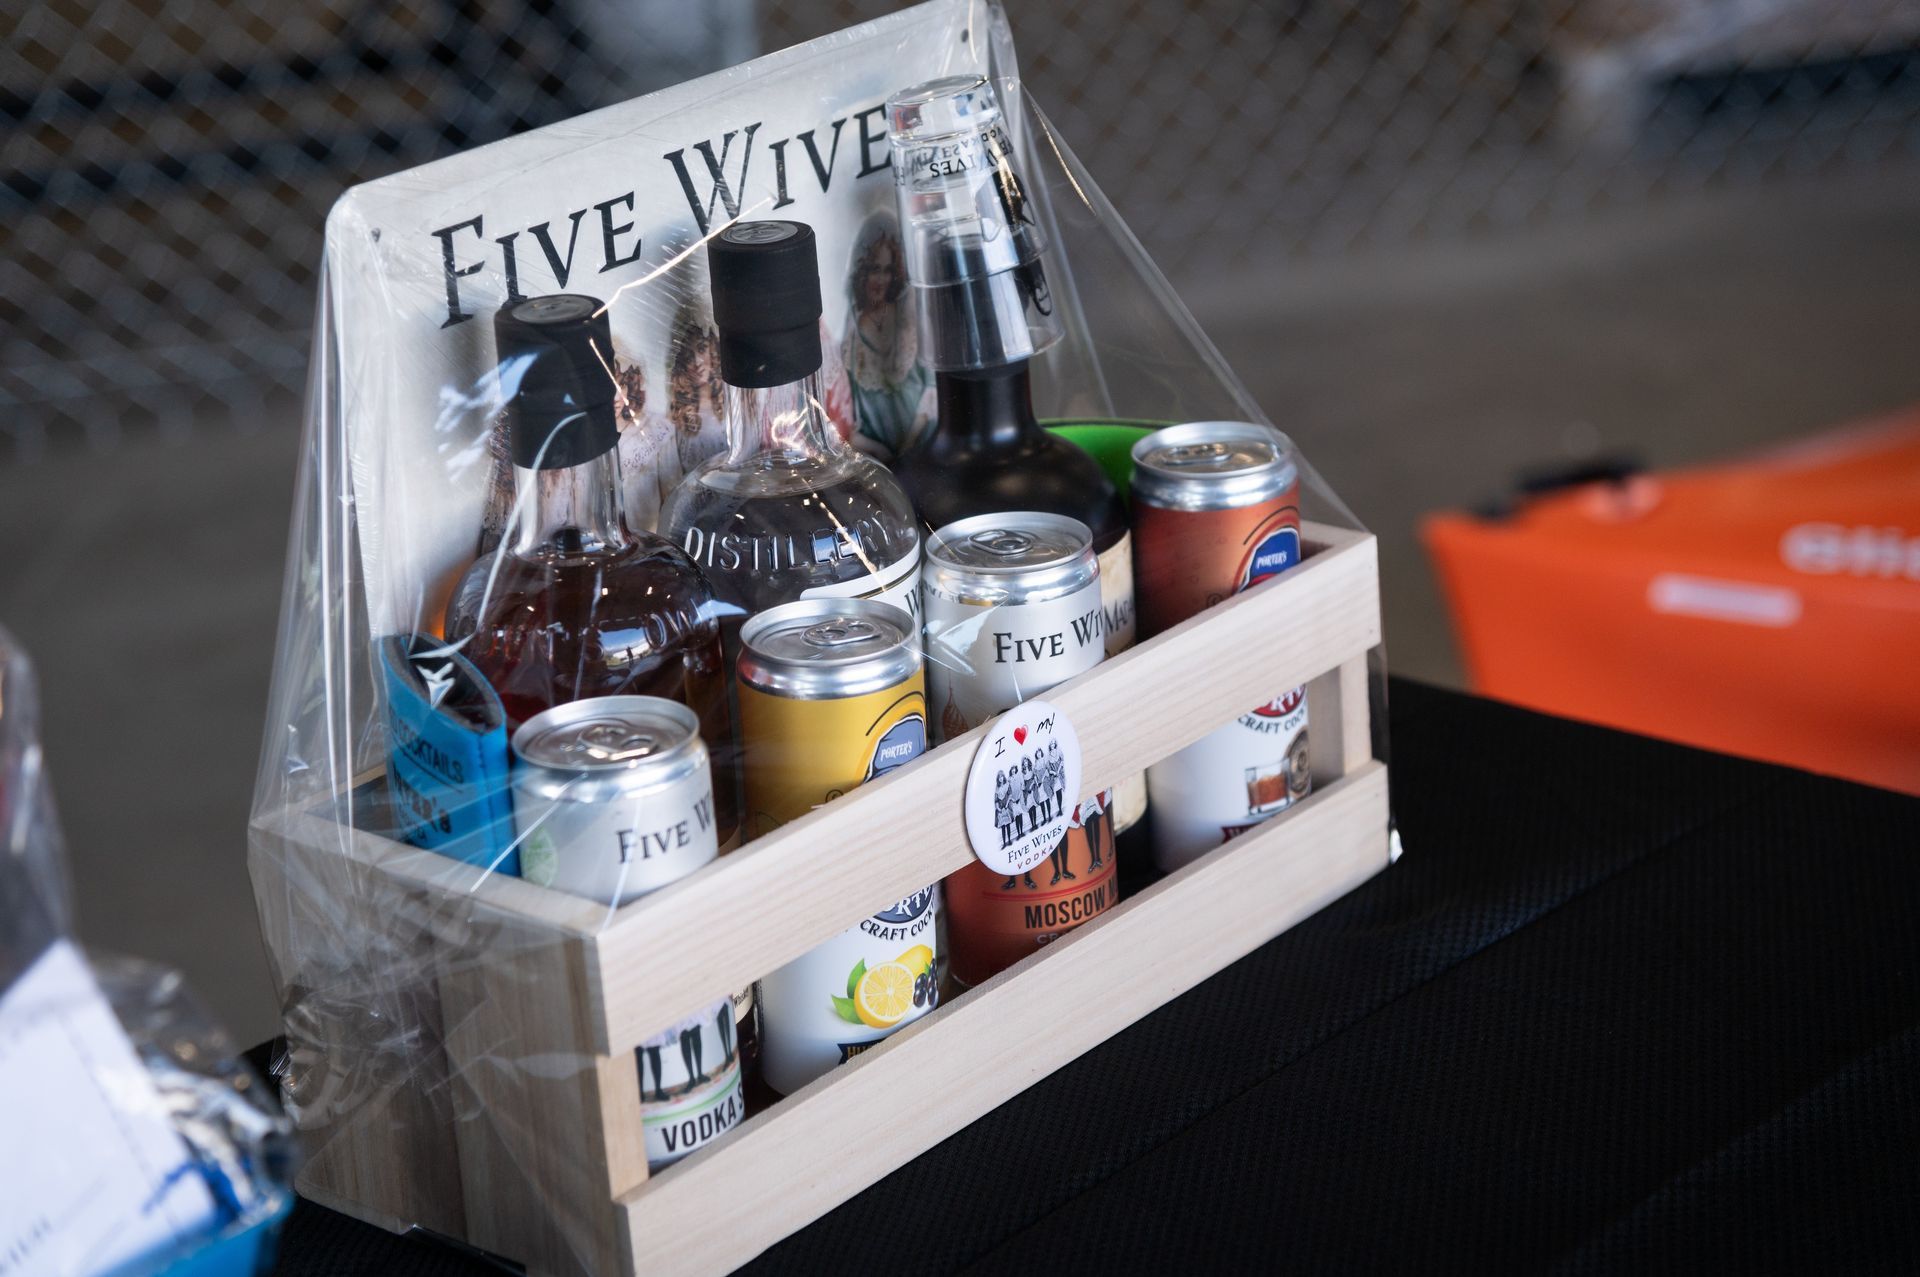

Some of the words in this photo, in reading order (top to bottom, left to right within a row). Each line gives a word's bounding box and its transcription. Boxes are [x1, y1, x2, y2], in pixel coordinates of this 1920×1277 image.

[431, 191, 641, 329] FIVE
[663, 103, 893, 238] WIVE
[684, 513, 892, 570] DISTILLERY
[1256, 550, 1288, 570] PORTER'S
[993, 632, 1065, 663] FIVE
[1238, 714, 1281, 734] CRAFT
[881, 741, 913, 762] PORTER'S
[995, 737, 1006, 758] I
[616, 820, 690, 864] FIVE
[1007, 845, 1030, 863] FIVE
[1031, 825, 1062, 848] WIVES
[1016, 845, 1054, 870] VODKA
[1024, 884, 1105, 929] MOSCOW
[860, 918, 908, 941] CRAFT
[661, 1095, 737, 1153] VODKA
